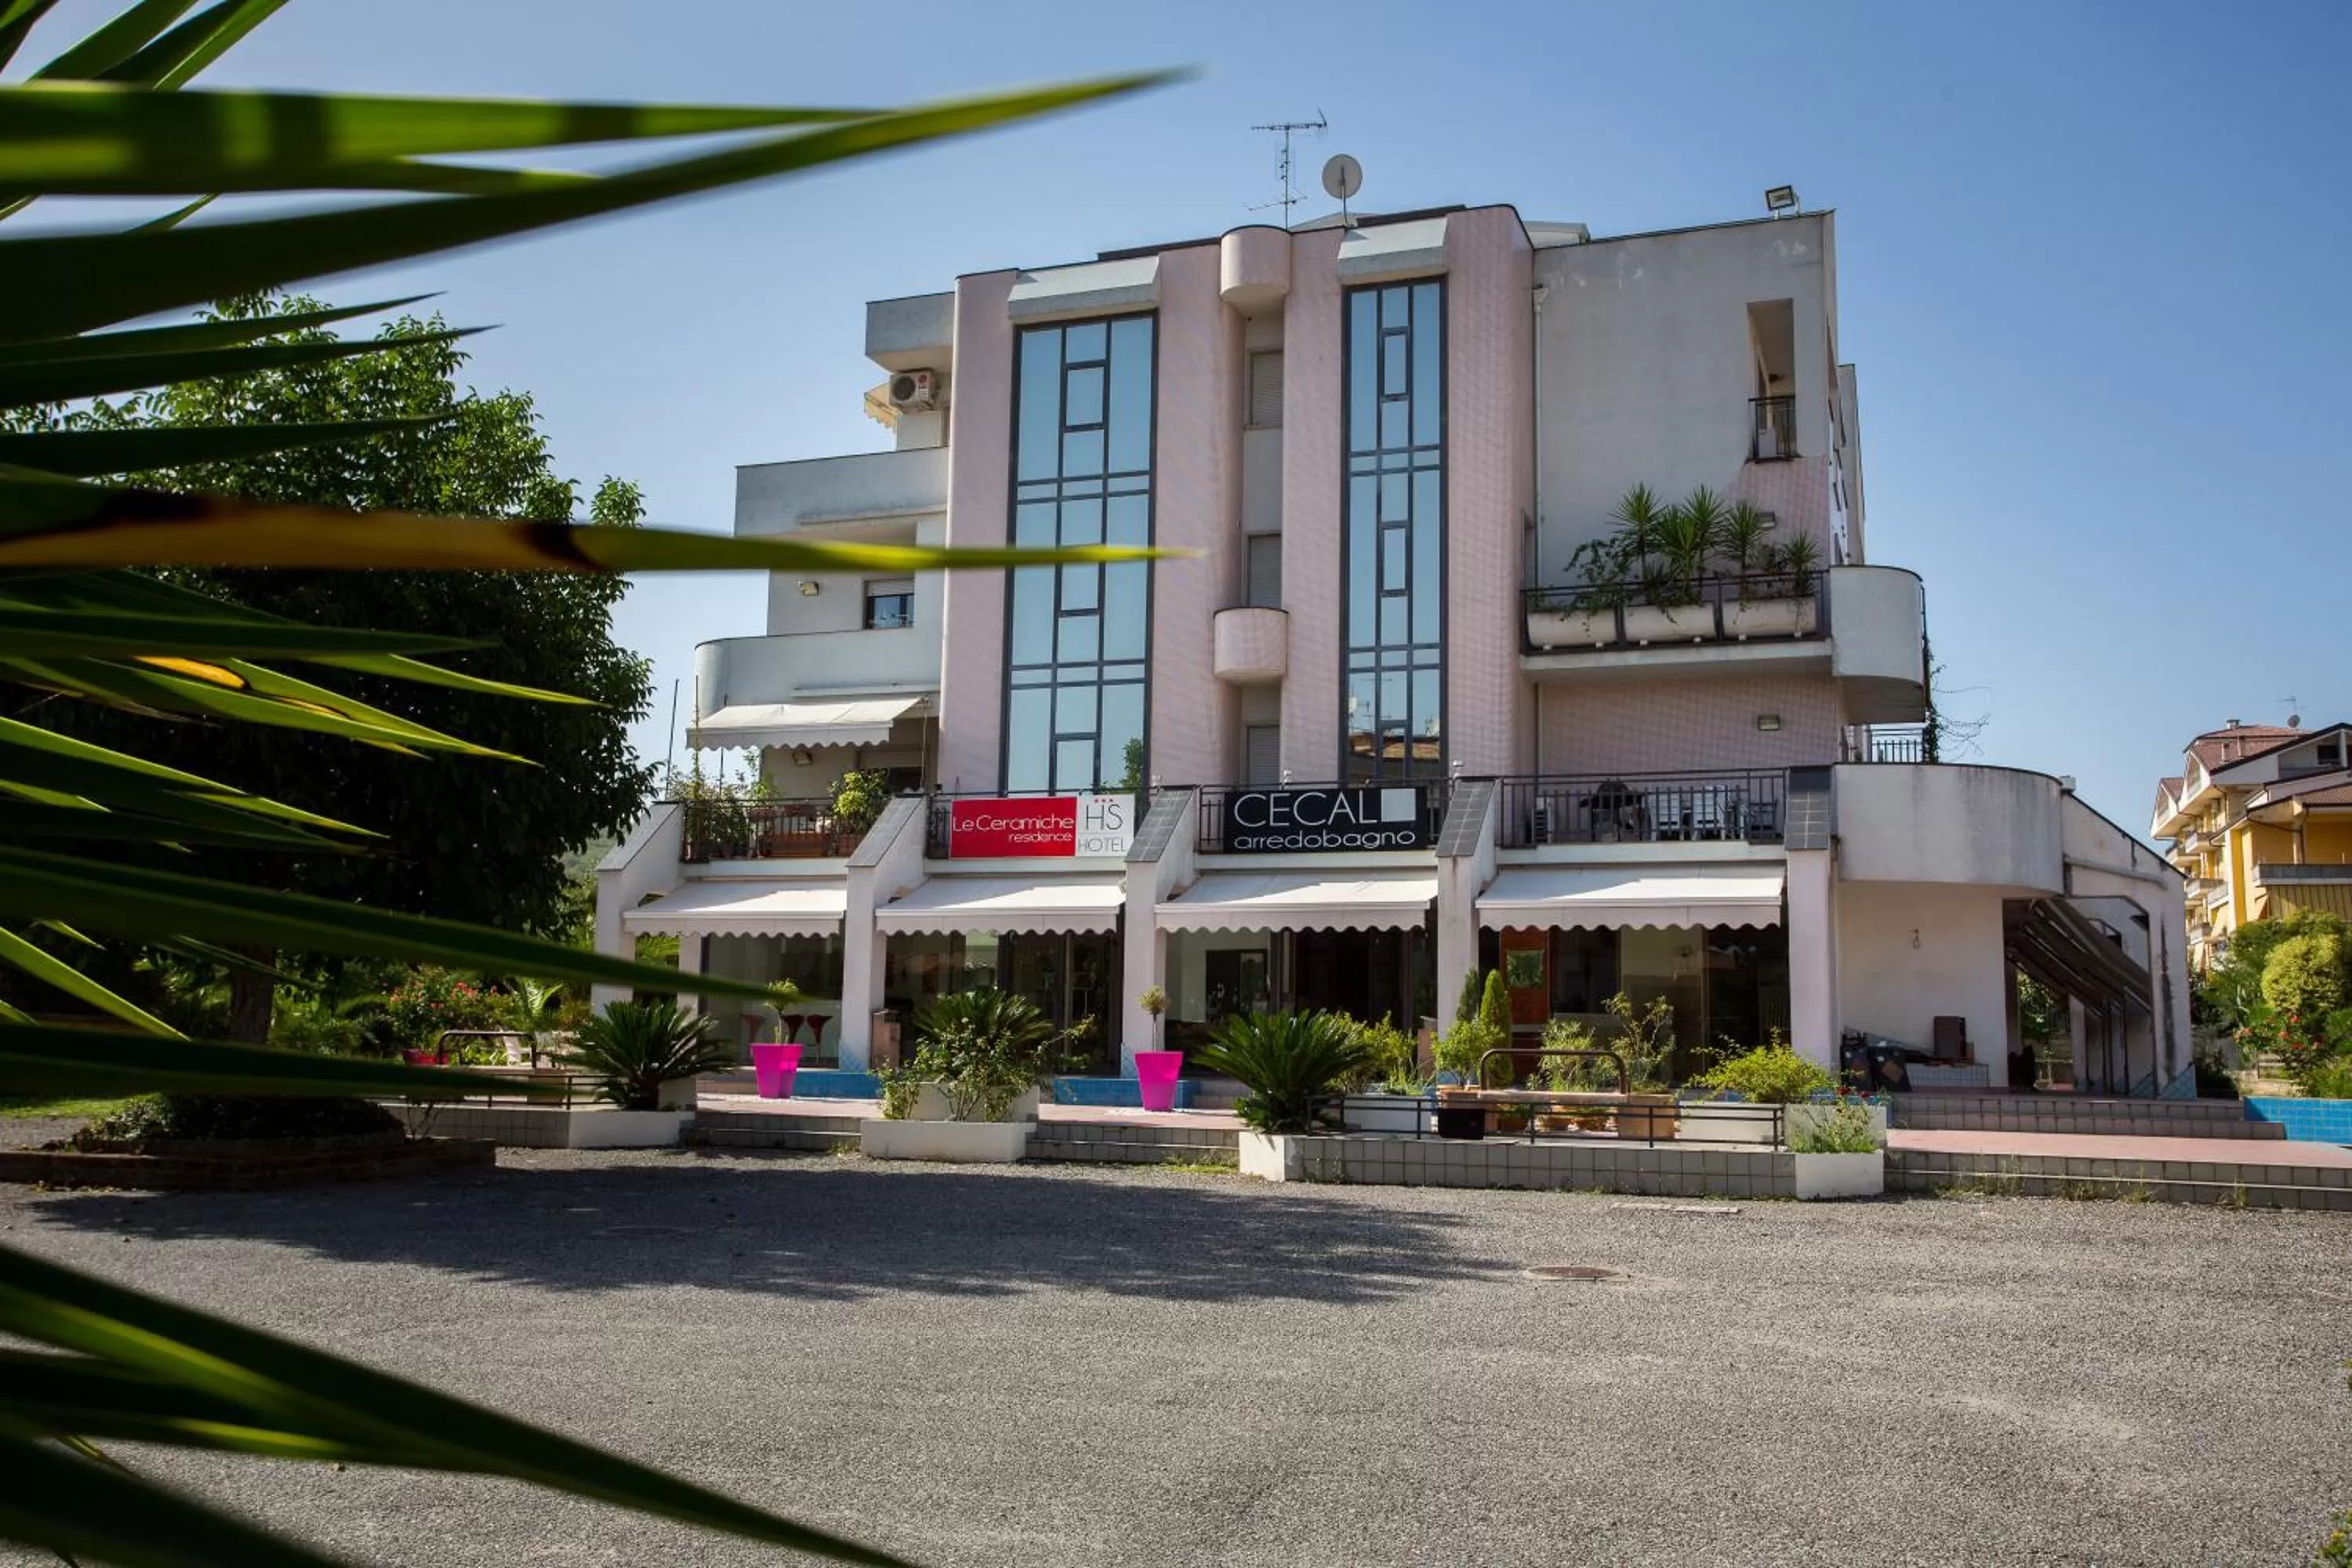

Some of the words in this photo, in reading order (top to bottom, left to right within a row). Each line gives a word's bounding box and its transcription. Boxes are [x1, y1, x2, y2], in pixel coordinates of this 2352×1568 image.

[1086, 804, 1123, 831] HS
[1234, 789, 1377, 827] CECAL
[953, 816, 974, 832] Le
[976, 813, 1075, 830] Ceramiche
[1008, 832, 1073, 844] residence
[1078, 837, 1127, 852] HOTEL
[1234, 829, 1416, 850] arredobagno
